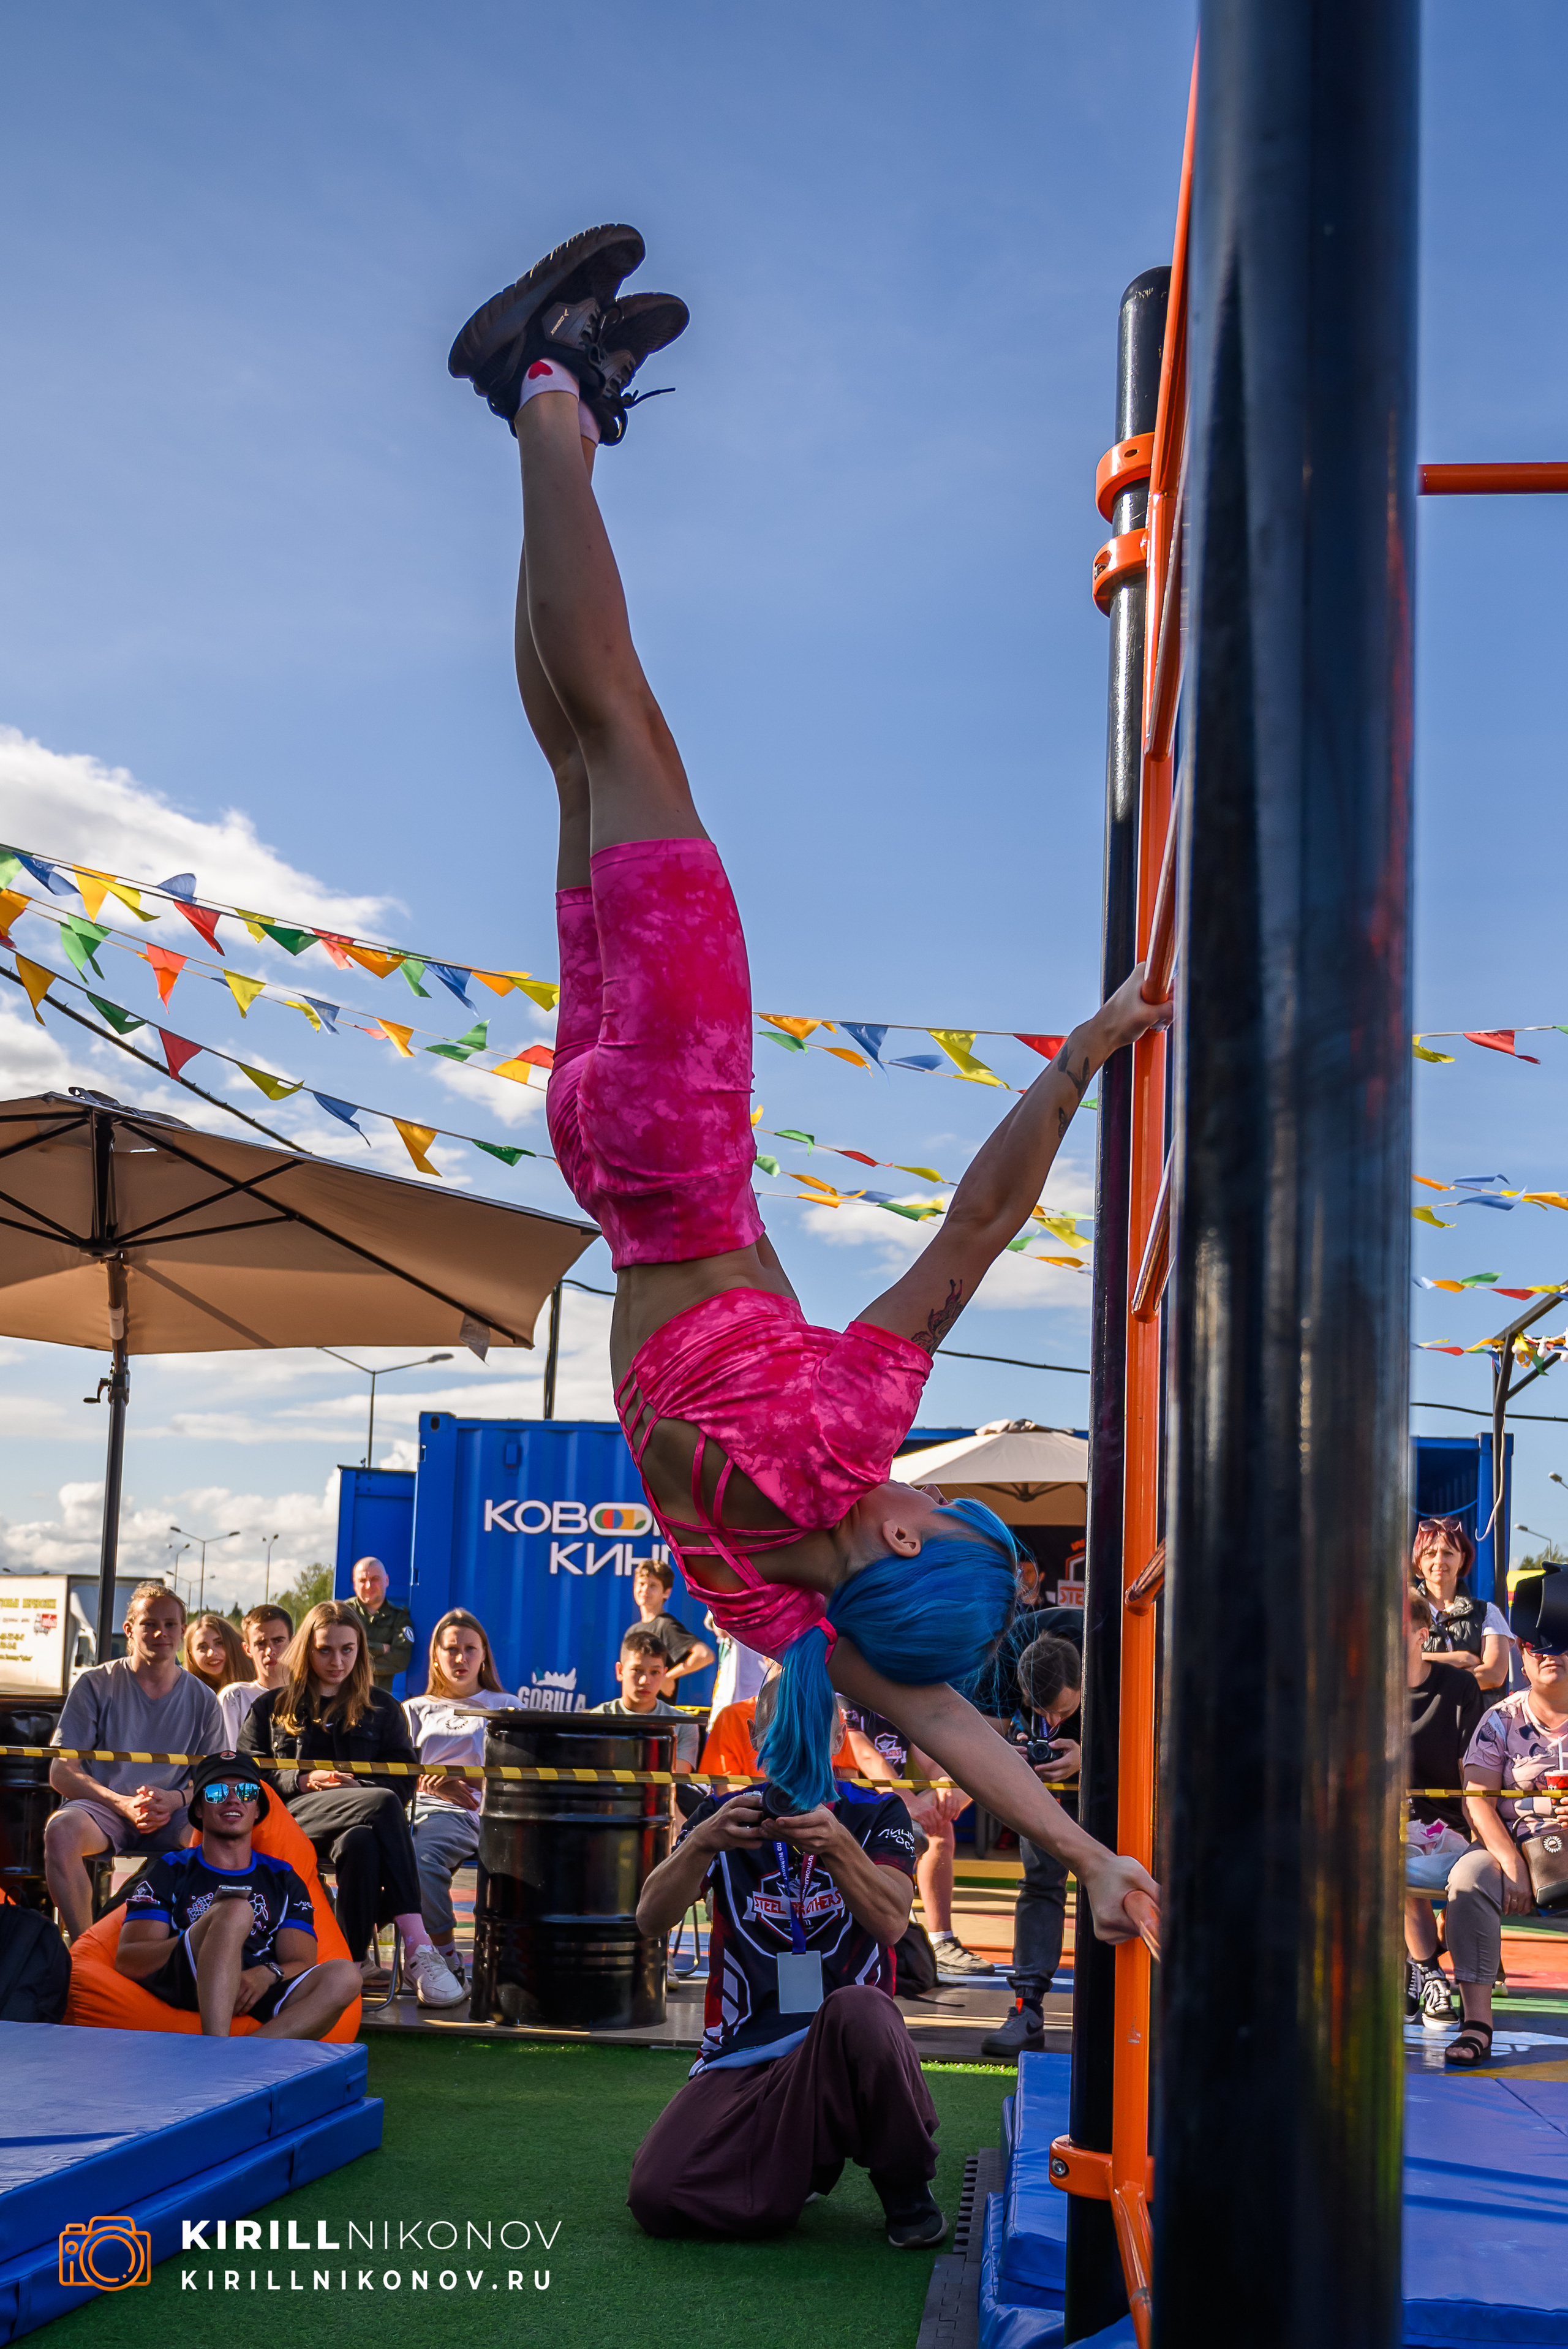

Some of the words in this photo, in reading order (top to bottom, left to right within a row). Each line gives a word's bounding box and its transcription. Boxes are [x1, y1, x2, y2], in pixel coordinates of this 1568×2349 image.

[484, 1499, 661, 1537] КОВО
[1059, 1586, 1085, 1605] STE
[517, 1686, 586, 1711] GORILLA
[753, 1895, 787, 1915] STEEL
